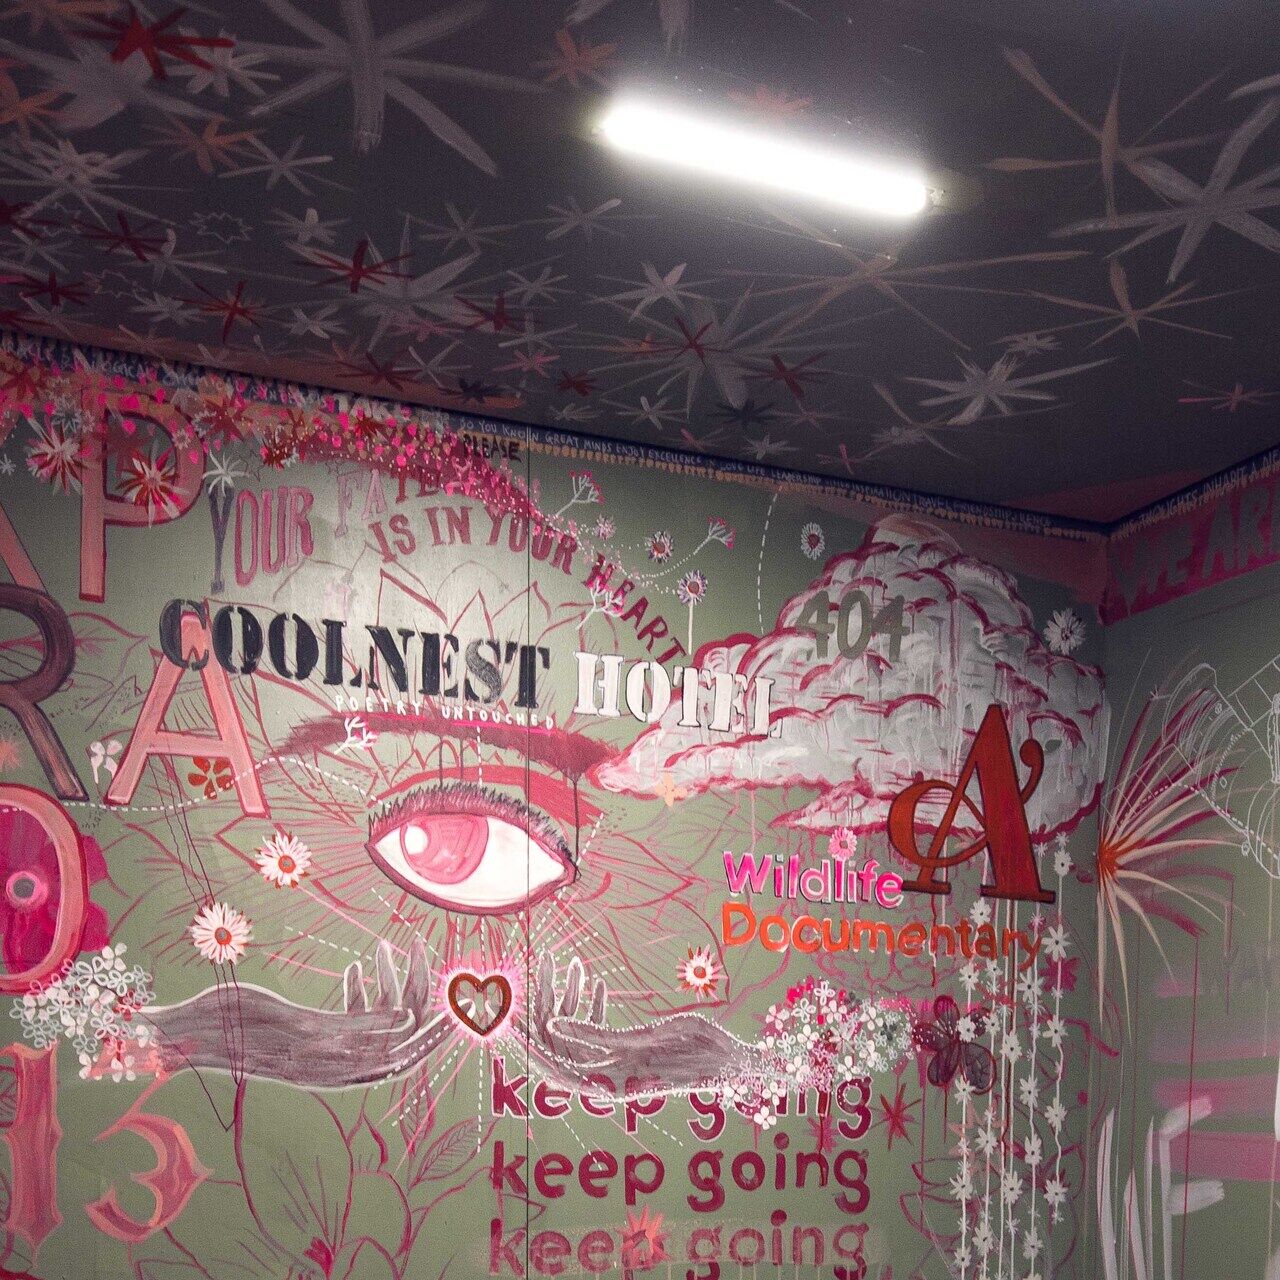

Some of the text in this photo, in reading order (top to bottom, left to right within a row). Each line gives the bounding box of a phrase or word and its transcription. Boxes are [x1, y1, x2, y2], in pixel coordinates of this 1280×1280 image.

[479, 420, 498, 434] YOU
[545, 431, 579, 448] GREAT
[584, 440, 612, 453] MINDS
[208, 484, 315, 594] YOUR
[368, 512, 418, 563] IS
[424, 504, 473, 547] IN
[795, 588, 912, 663] 404
[159, 598, 783, 740] COOLNEST HOTEL
[335, 693, 555, 731] POETRY UNTOUCHED
[887, 703, 1056, 905] A
[722, 849, 906, 908] Wildlife
[721, 901, 1045, 972] Documentary
[489, 1132, 872, 1212] keep going
